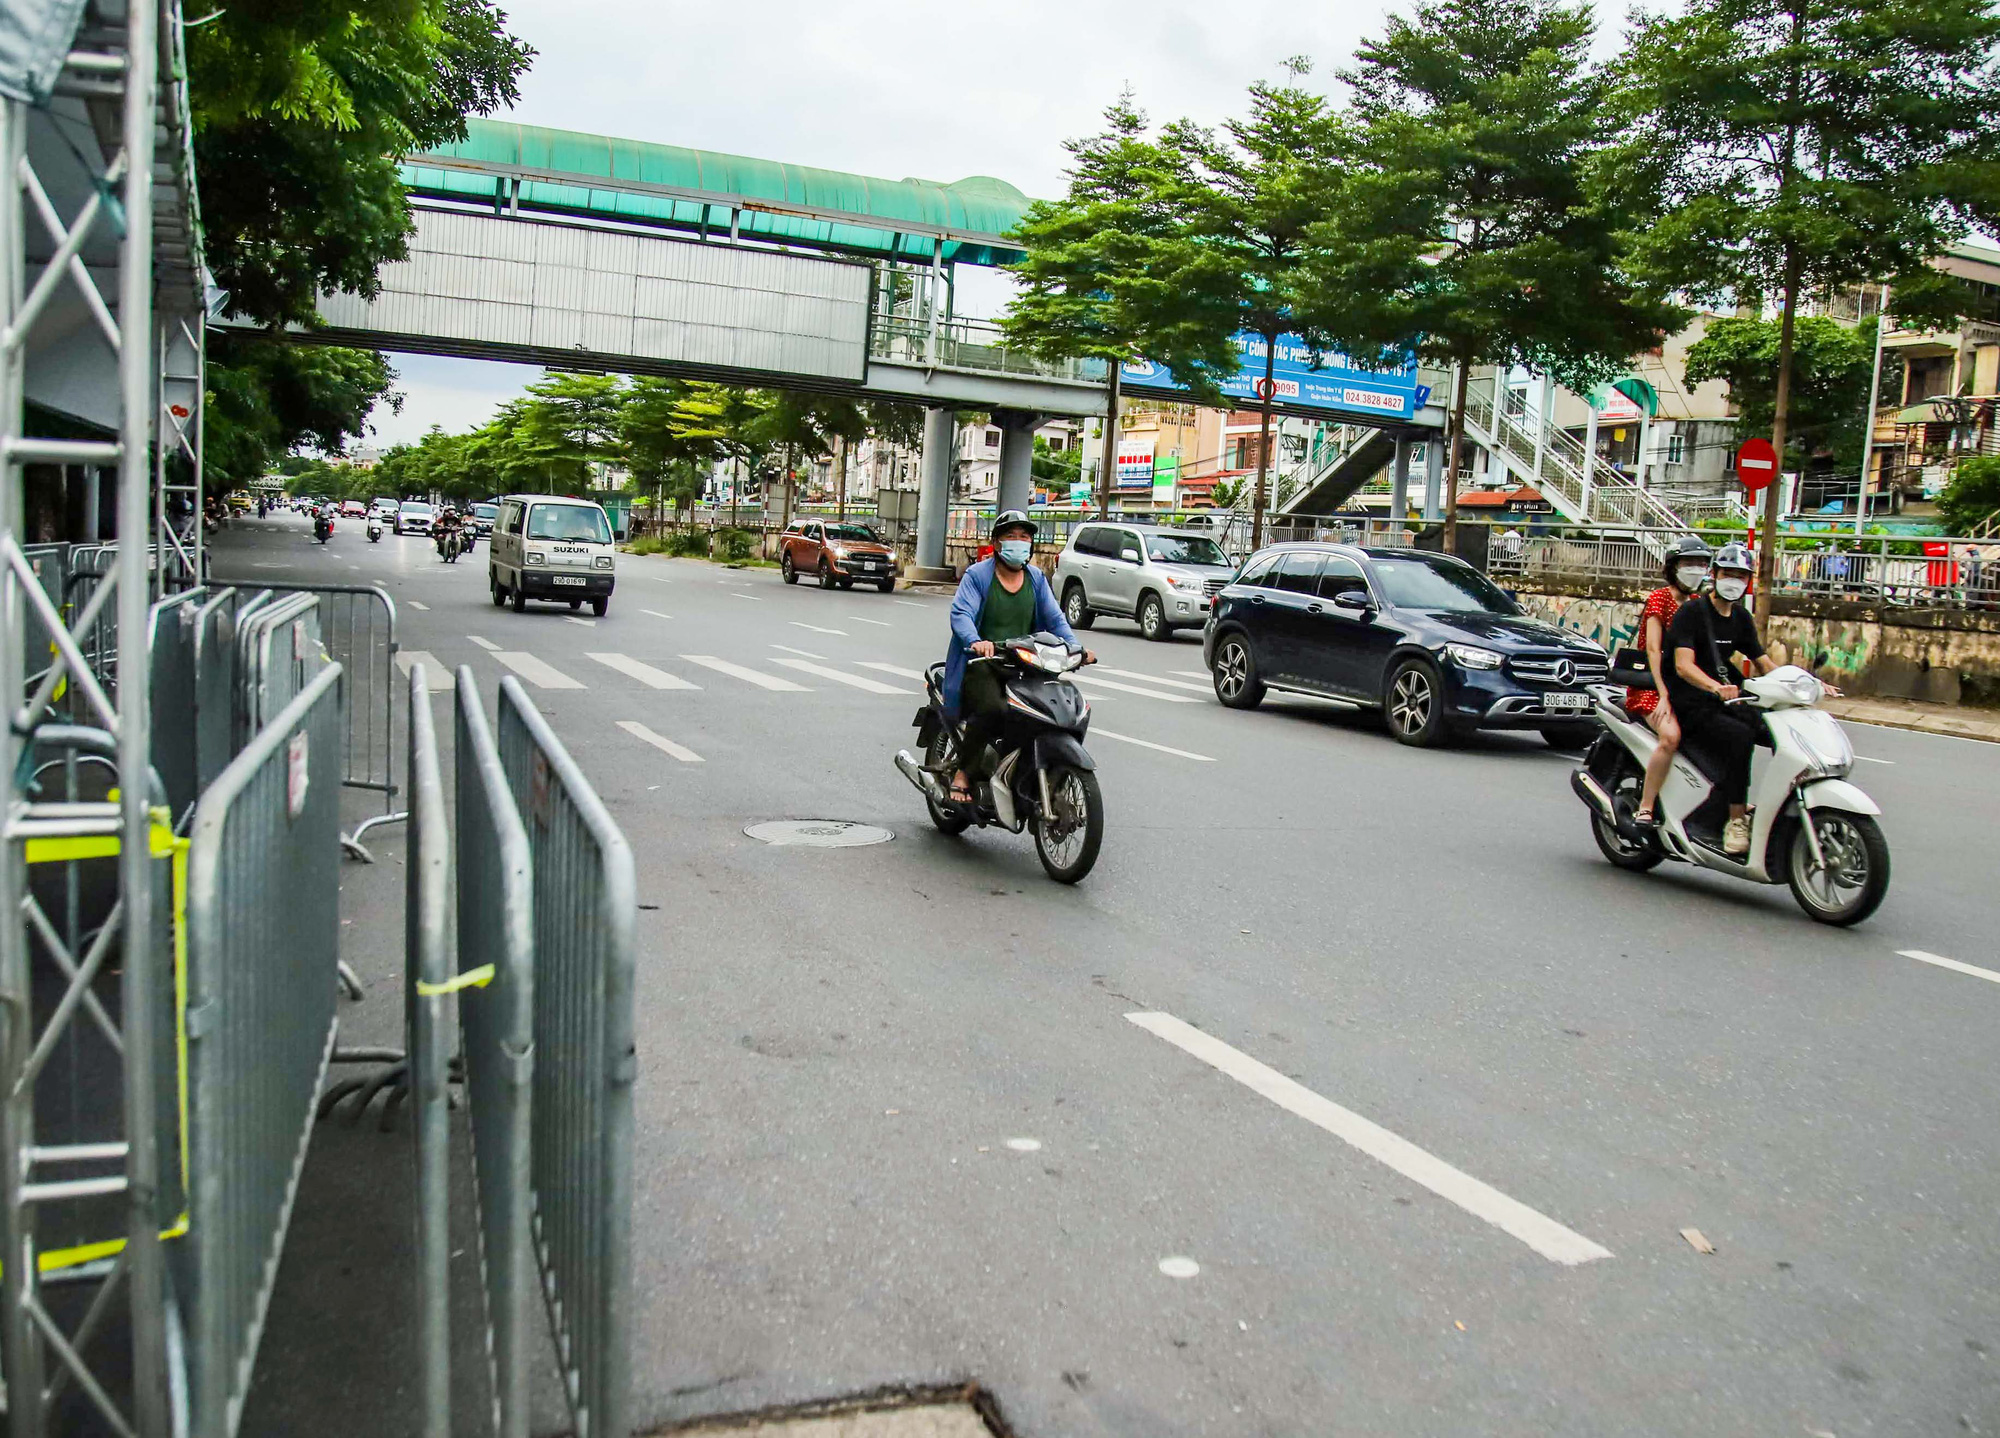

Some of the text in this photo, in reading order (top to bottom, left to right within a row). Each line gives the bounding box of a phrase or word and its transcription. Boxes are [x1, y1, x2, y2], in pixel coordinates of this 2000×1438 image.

[1274, 343, 1289, 361] TÁC
[1382, 396, 1402, 409] 4827
[553, 546, 589, 554] SUZUKI
